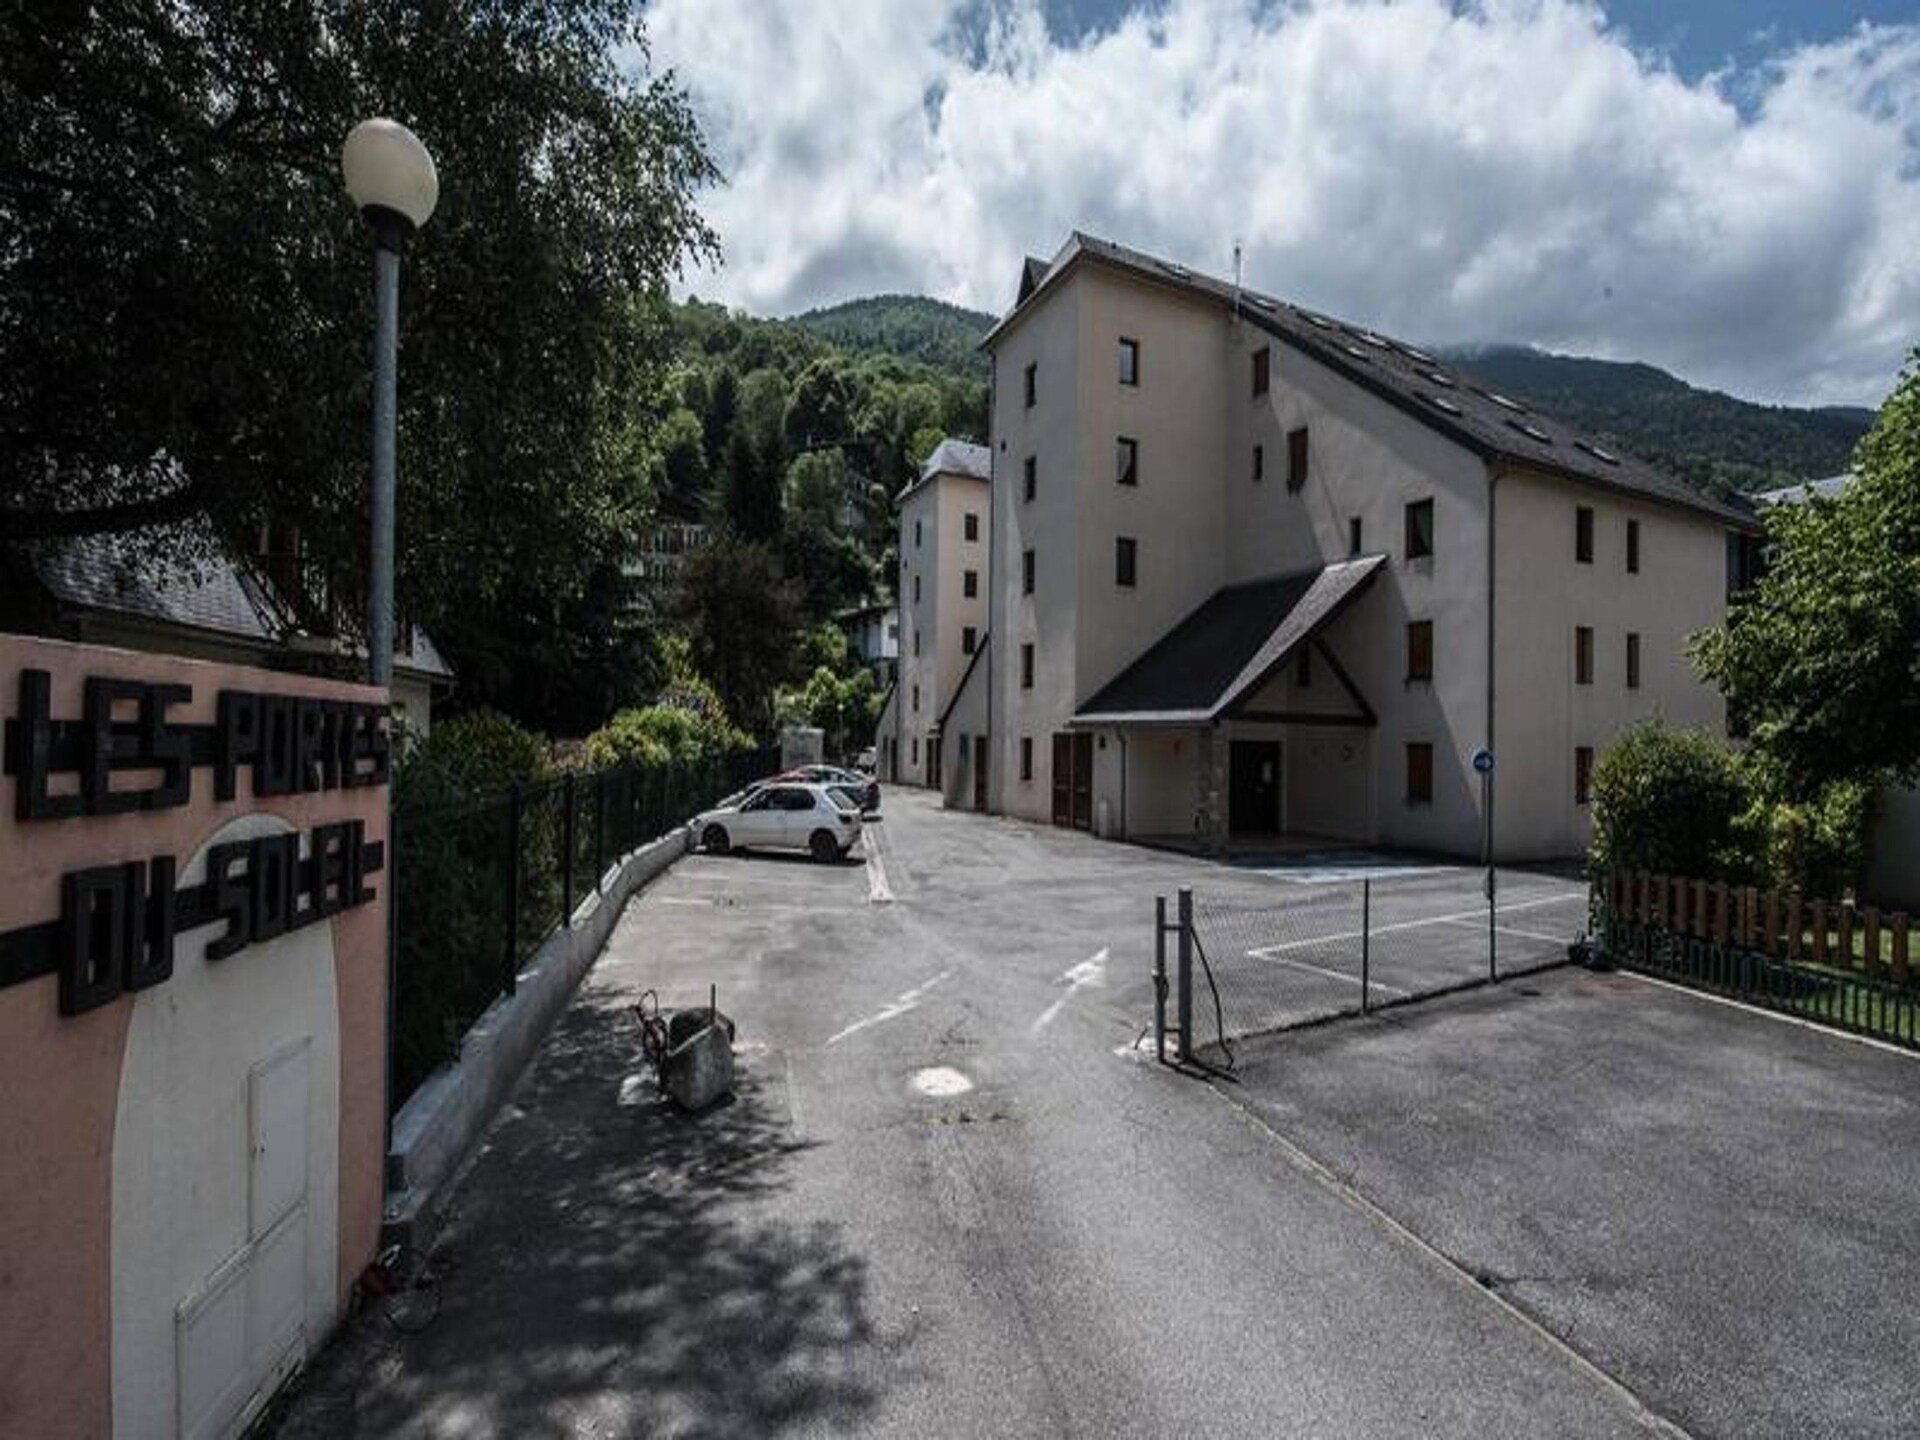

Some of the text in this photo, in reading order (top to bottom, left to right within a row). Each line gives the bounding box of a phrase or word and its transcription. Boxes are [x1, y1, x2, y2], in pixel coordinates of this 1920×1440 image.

[16, 669, 389, 821] LES PORTES
[58, 820, 379, 1018] DU SOLEIL
